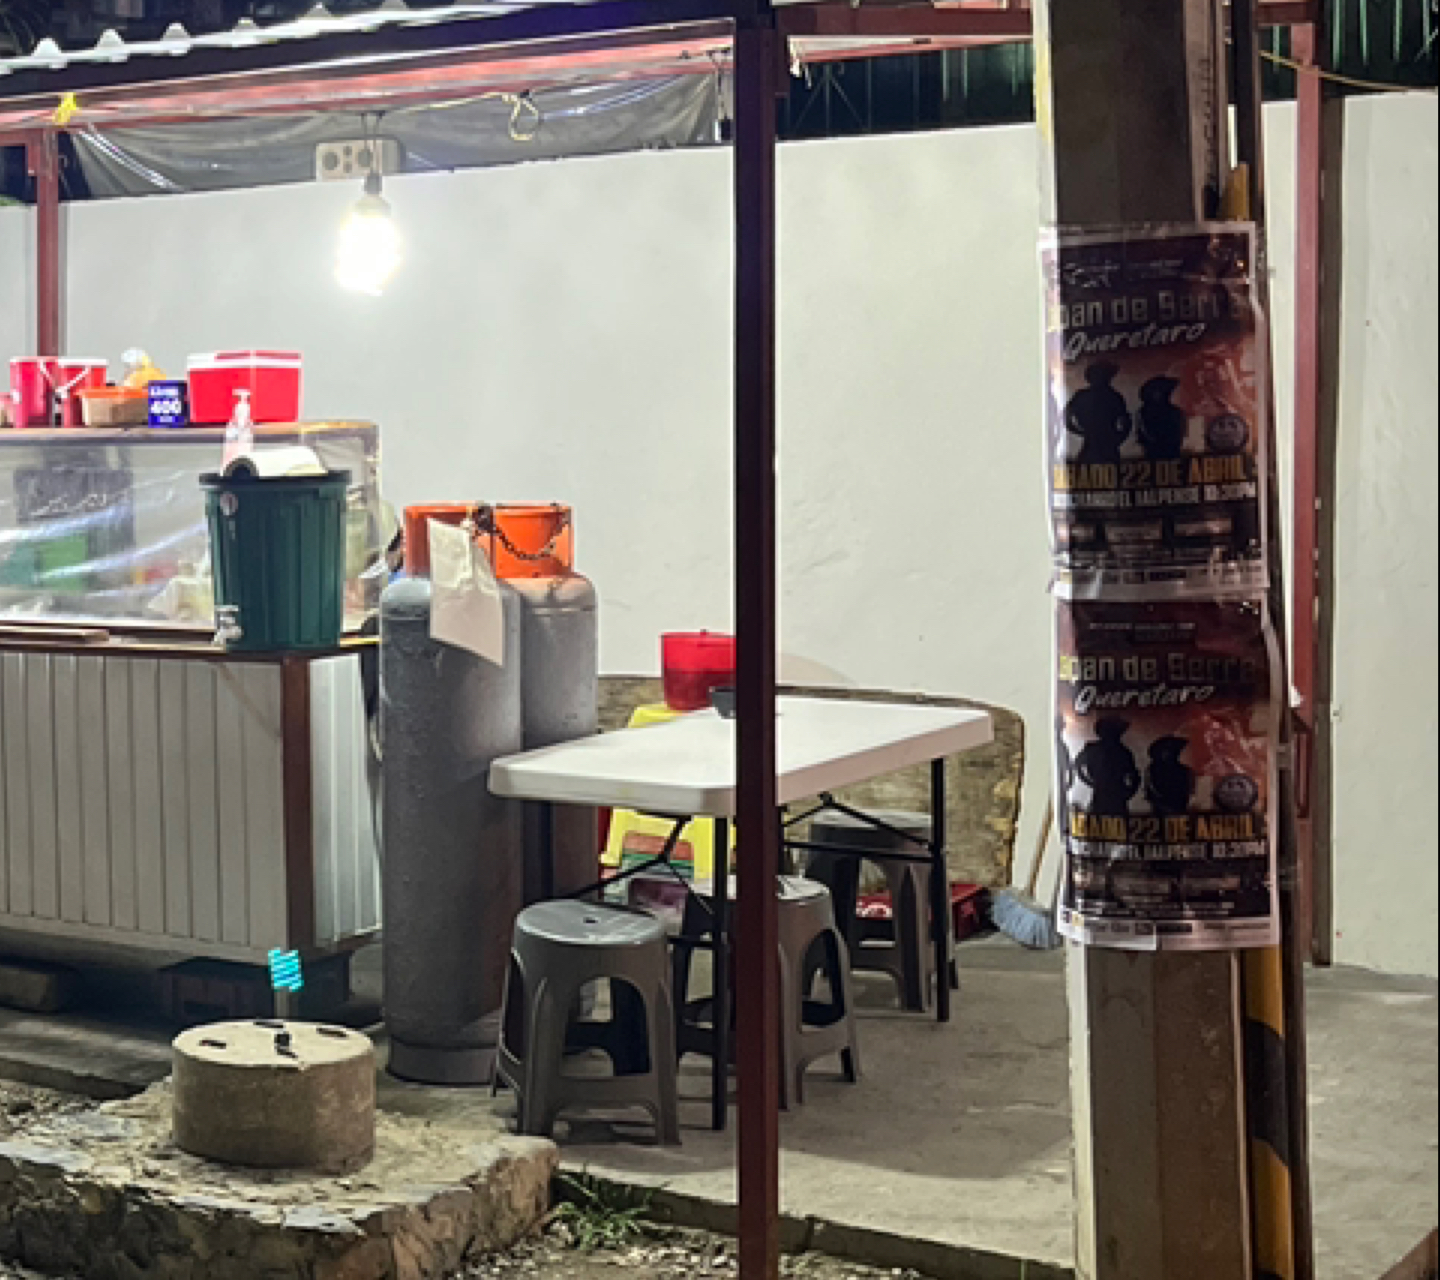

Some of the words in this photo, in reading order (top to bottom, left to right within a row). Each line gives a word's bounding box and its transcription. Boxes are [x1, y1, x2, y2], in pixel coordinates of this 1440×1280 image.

[1111, 295, 1149, 325] de
[1120, 460, 1152, 489] 22
[1122, 655, 1158, 681] de
[1129, 816, 1161, 843] 22
[1195, 813, 1255, 840] ABRIL
